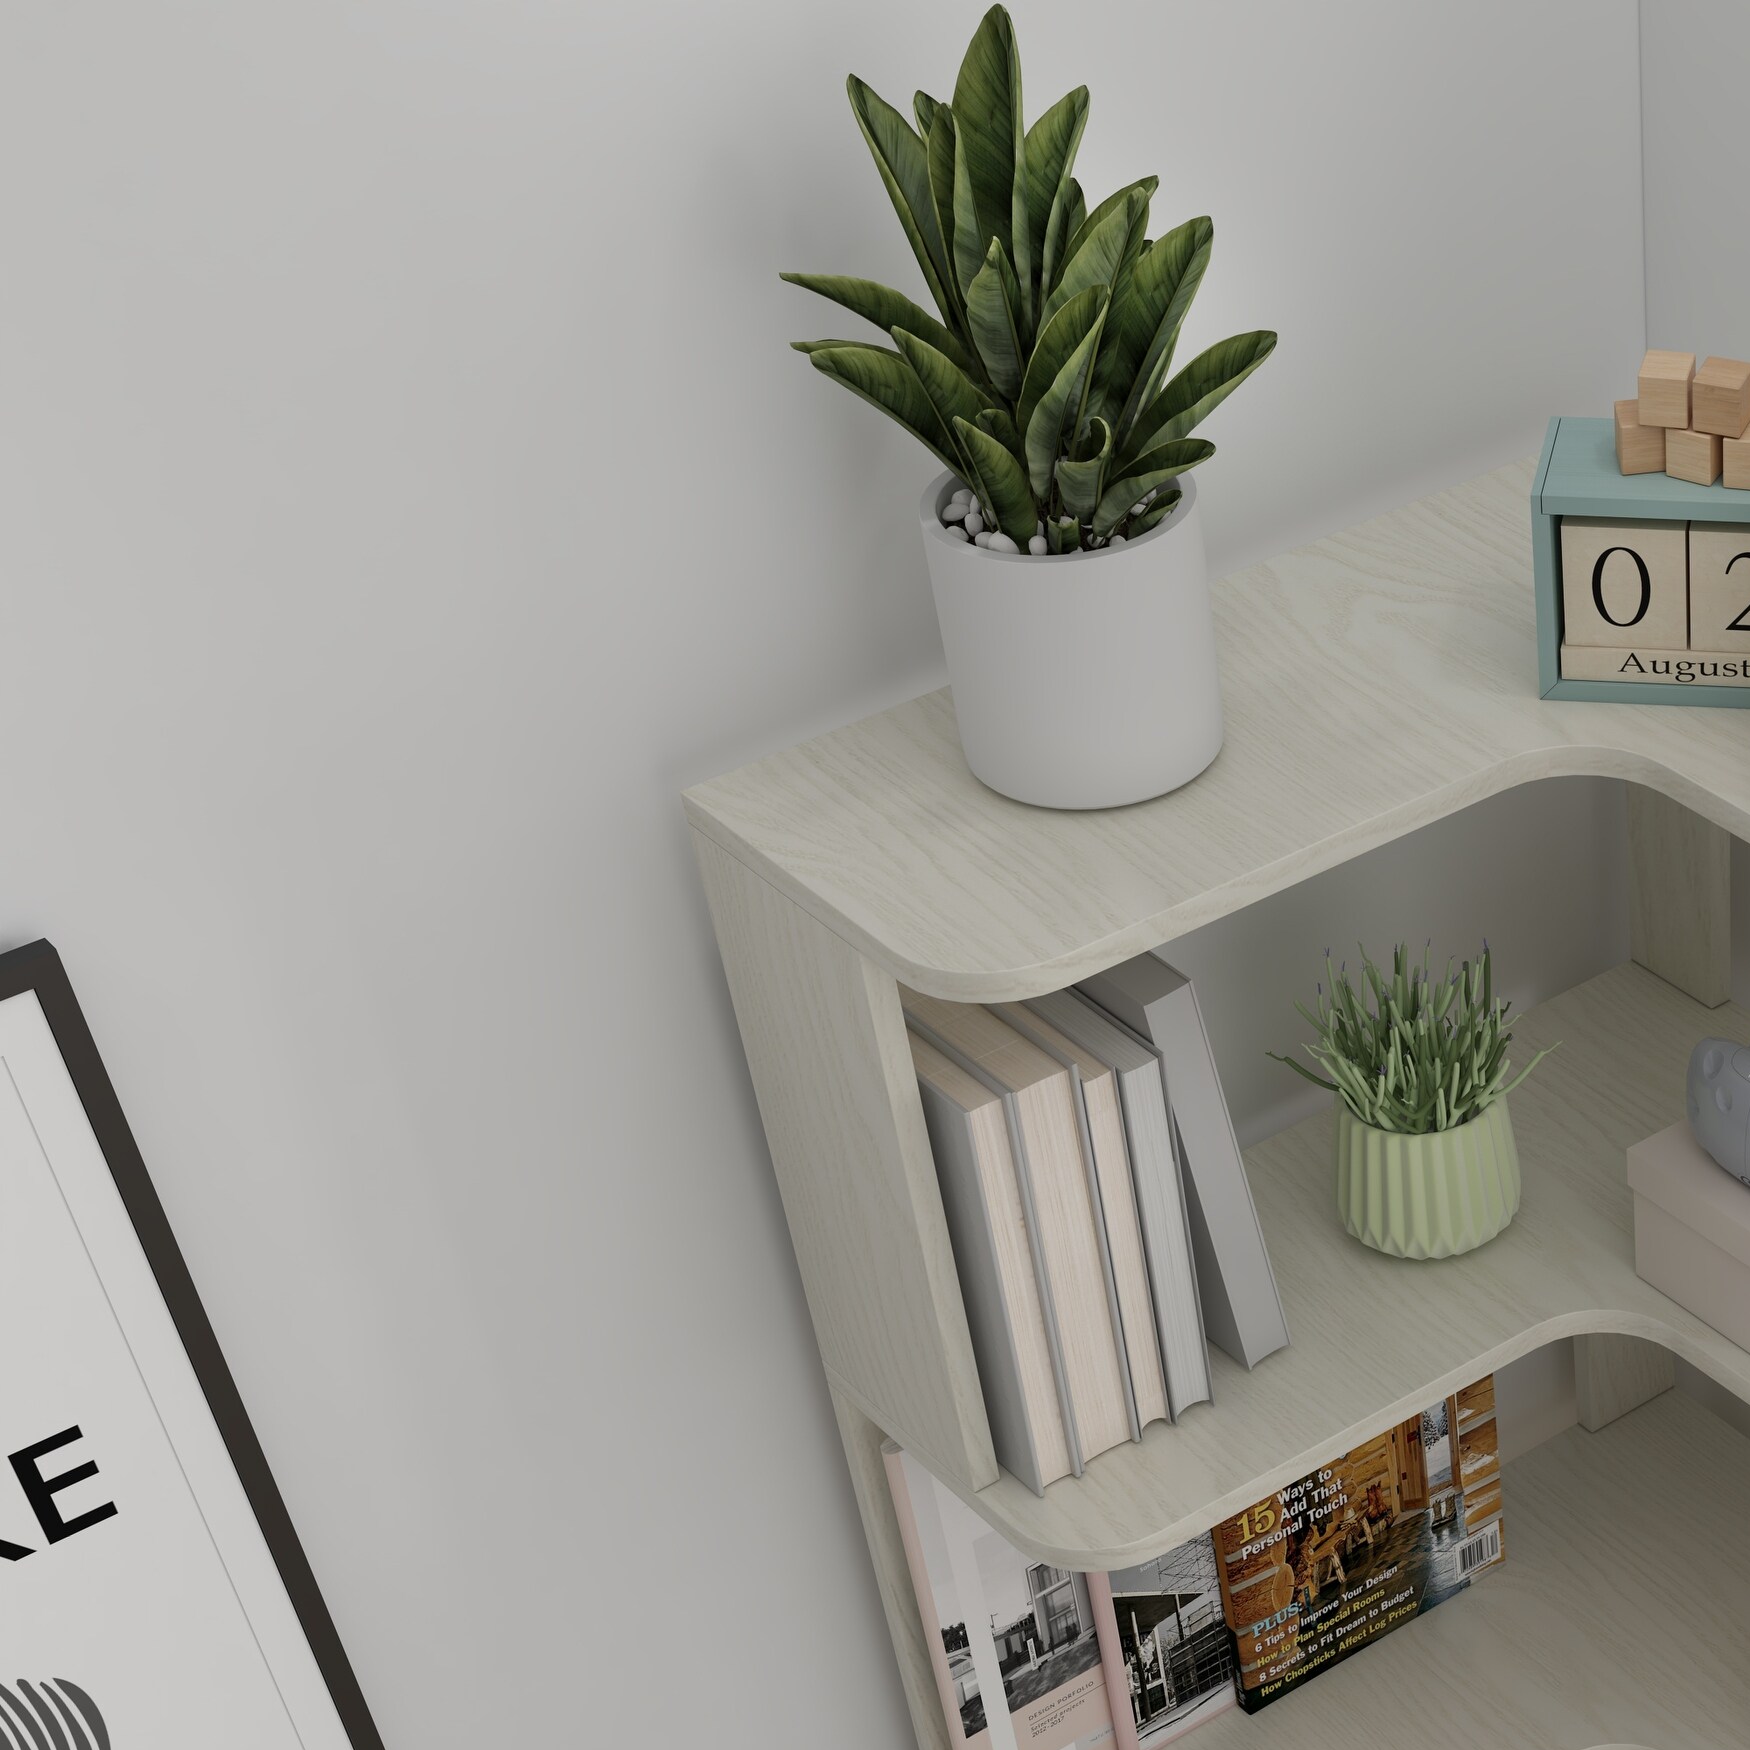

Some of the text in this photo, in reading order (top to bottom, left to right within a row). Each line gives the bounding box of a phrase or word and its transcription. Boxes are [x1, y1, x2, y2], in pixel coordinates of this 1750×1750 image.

[0, 1424, 118, 1561] E
[1237, 1478, 1343, 1544] 15 Add That
[1277, 1469, 1332, 1505] Ways to
[1242, 1493, 1348, 1560] Personal Touch
[1252, 1601, 1303, 1639] PLUS:
[1255, 1565, 1398, 1653] 6 Tips to Improve Your Design
[1257, 1588, 1385, 1668] How to Plan Special Rooms
[1259, 1585, 1414, 1682] 8 Secrets to Fit Dream to Budget
[1261, 1680, 1282, 1697] How
[1285, 1649, 1336, 1683] Chopsticks
[1338, 1630, 1367, 1652] Affect
[1369, 1618, 1387, 1633] Log
[1388, 1600, 1418, 1622] Prices
[1028, 1681, 1094, 1721] DESIGN PORFOLIO
